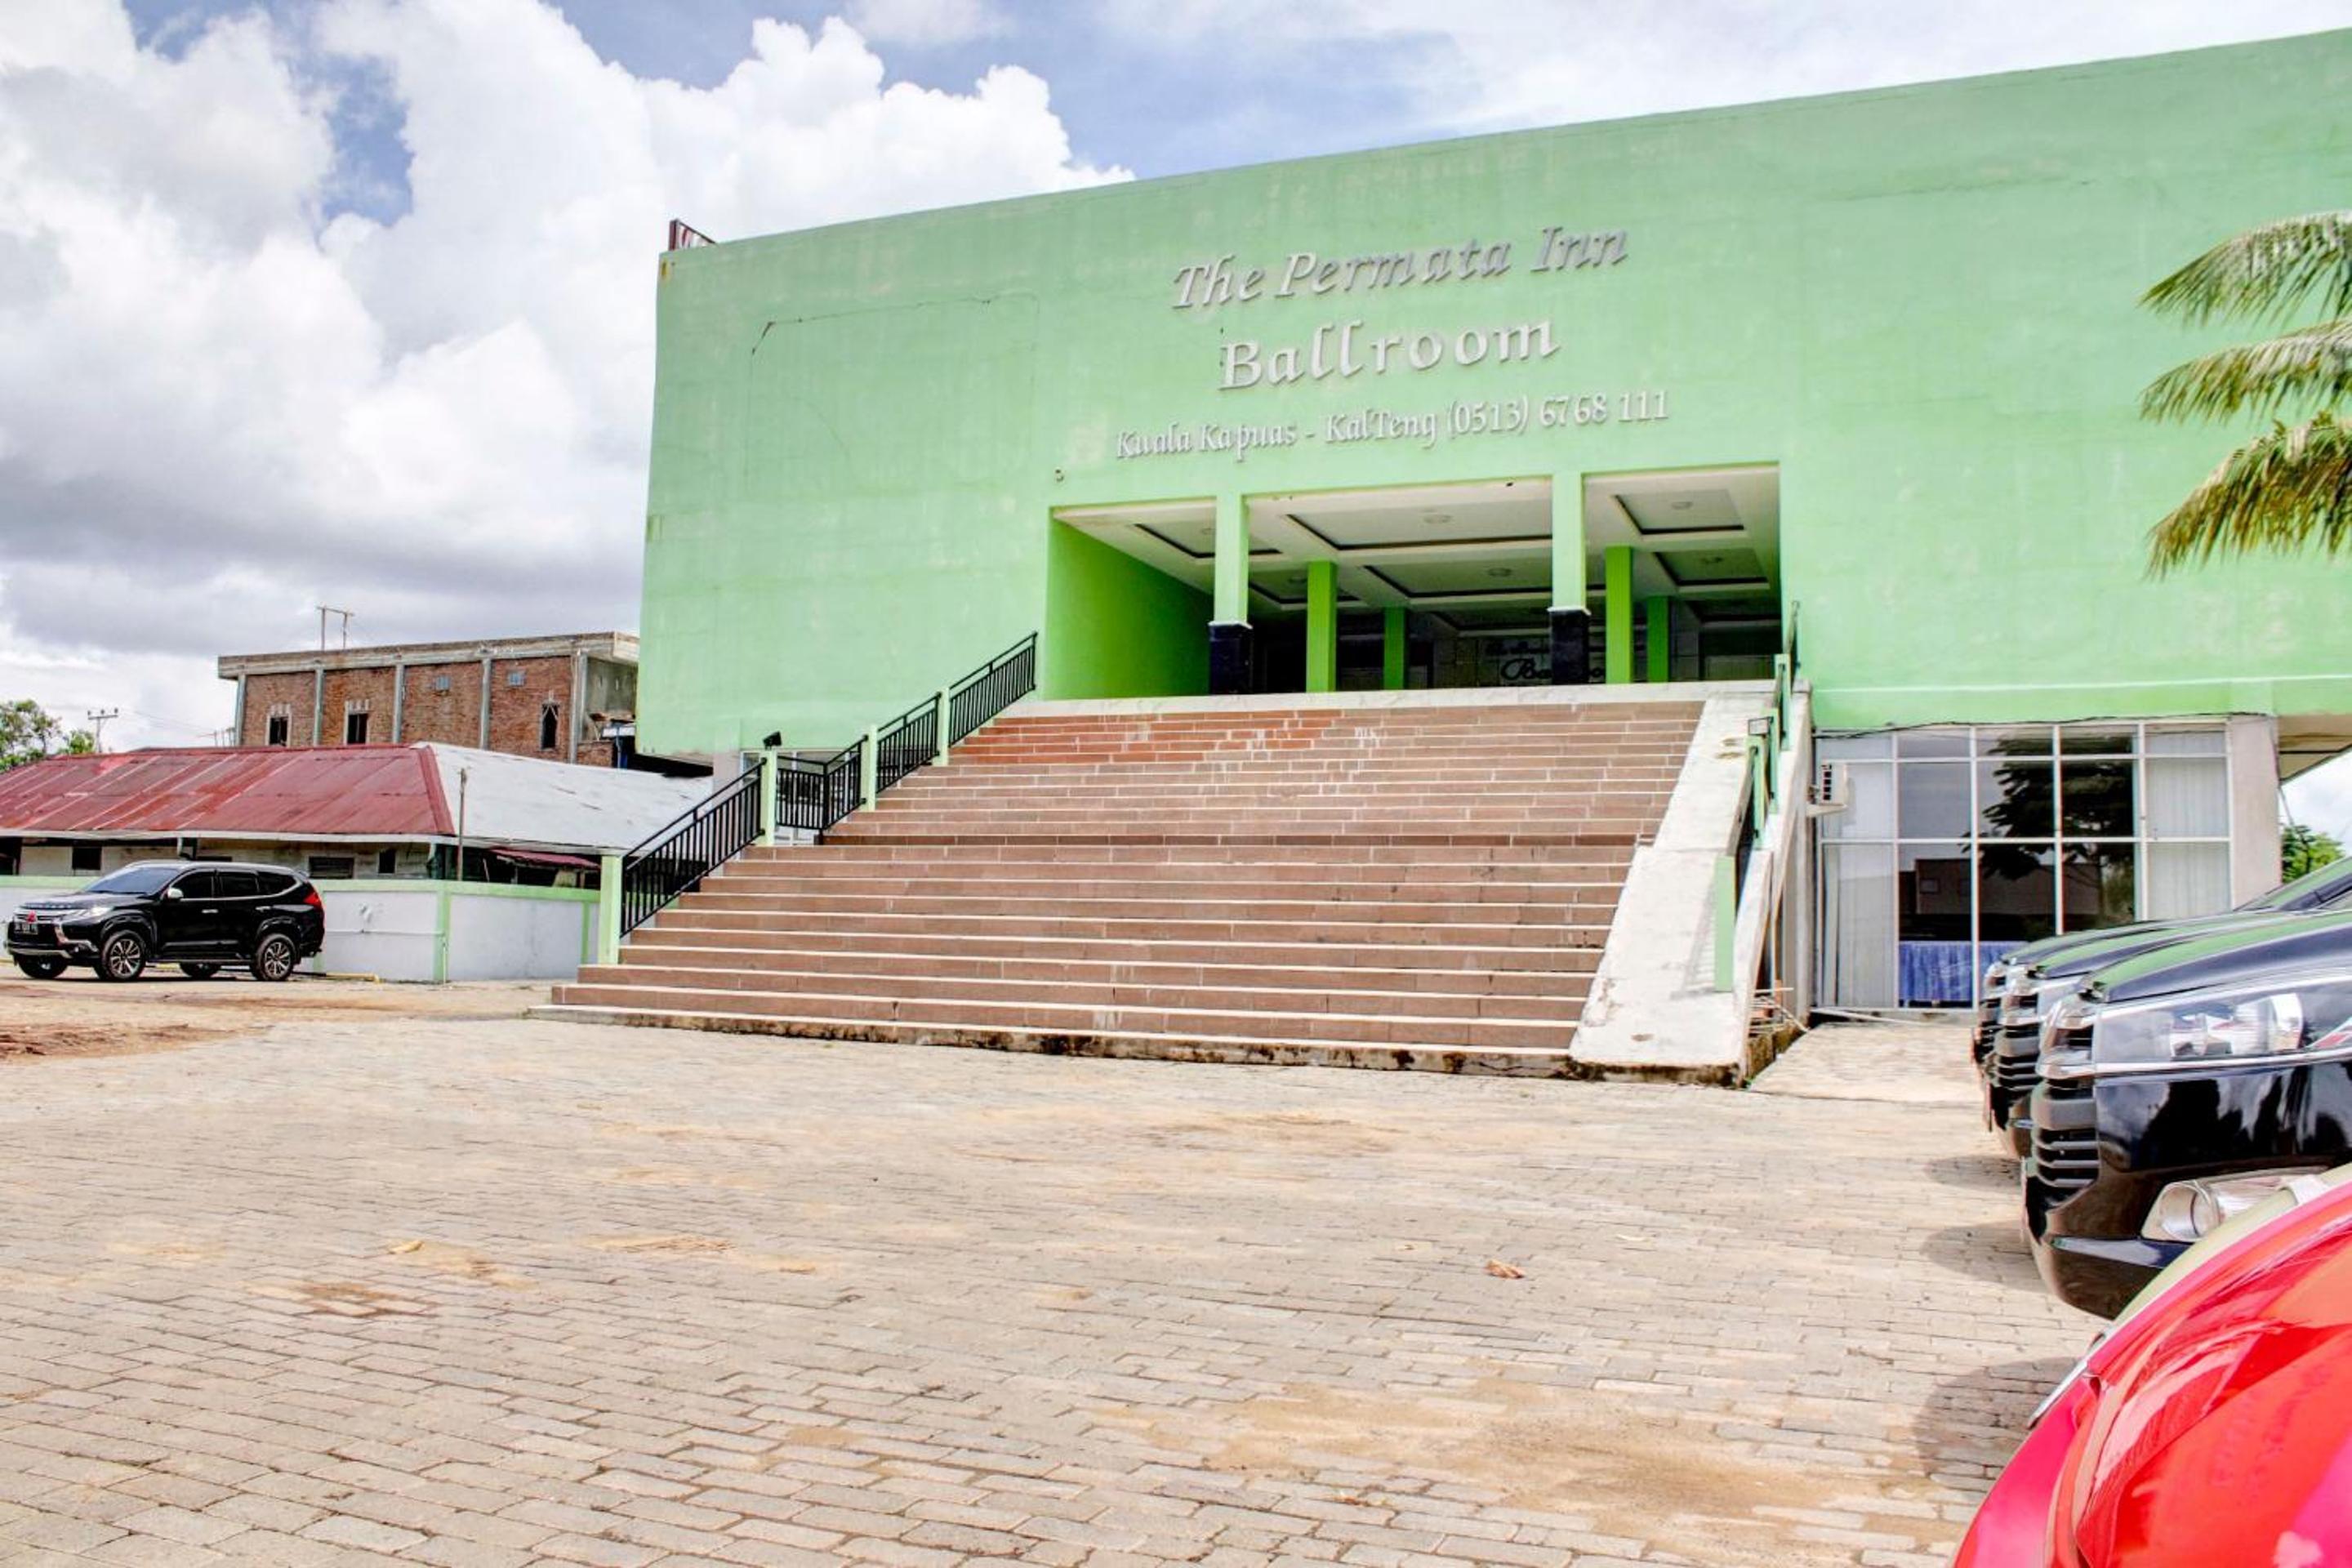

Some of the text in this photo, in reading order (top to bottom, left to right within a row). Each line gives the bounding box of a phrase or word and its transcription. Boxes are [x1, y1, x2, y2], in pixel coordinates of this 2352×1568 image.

[1173, 226, 1629, 310] The Permata Inn
[1218, 319, 1561, 391] Ballroom
[1116, 421, 1193, 460] Kuala
[1200, 422, 1298, 463] Kapuas
[1446, 394, 1530, 439] (0513)
[1539, 391, 1608, 427] 6768
[1618, 390, 1669, 423] 111
